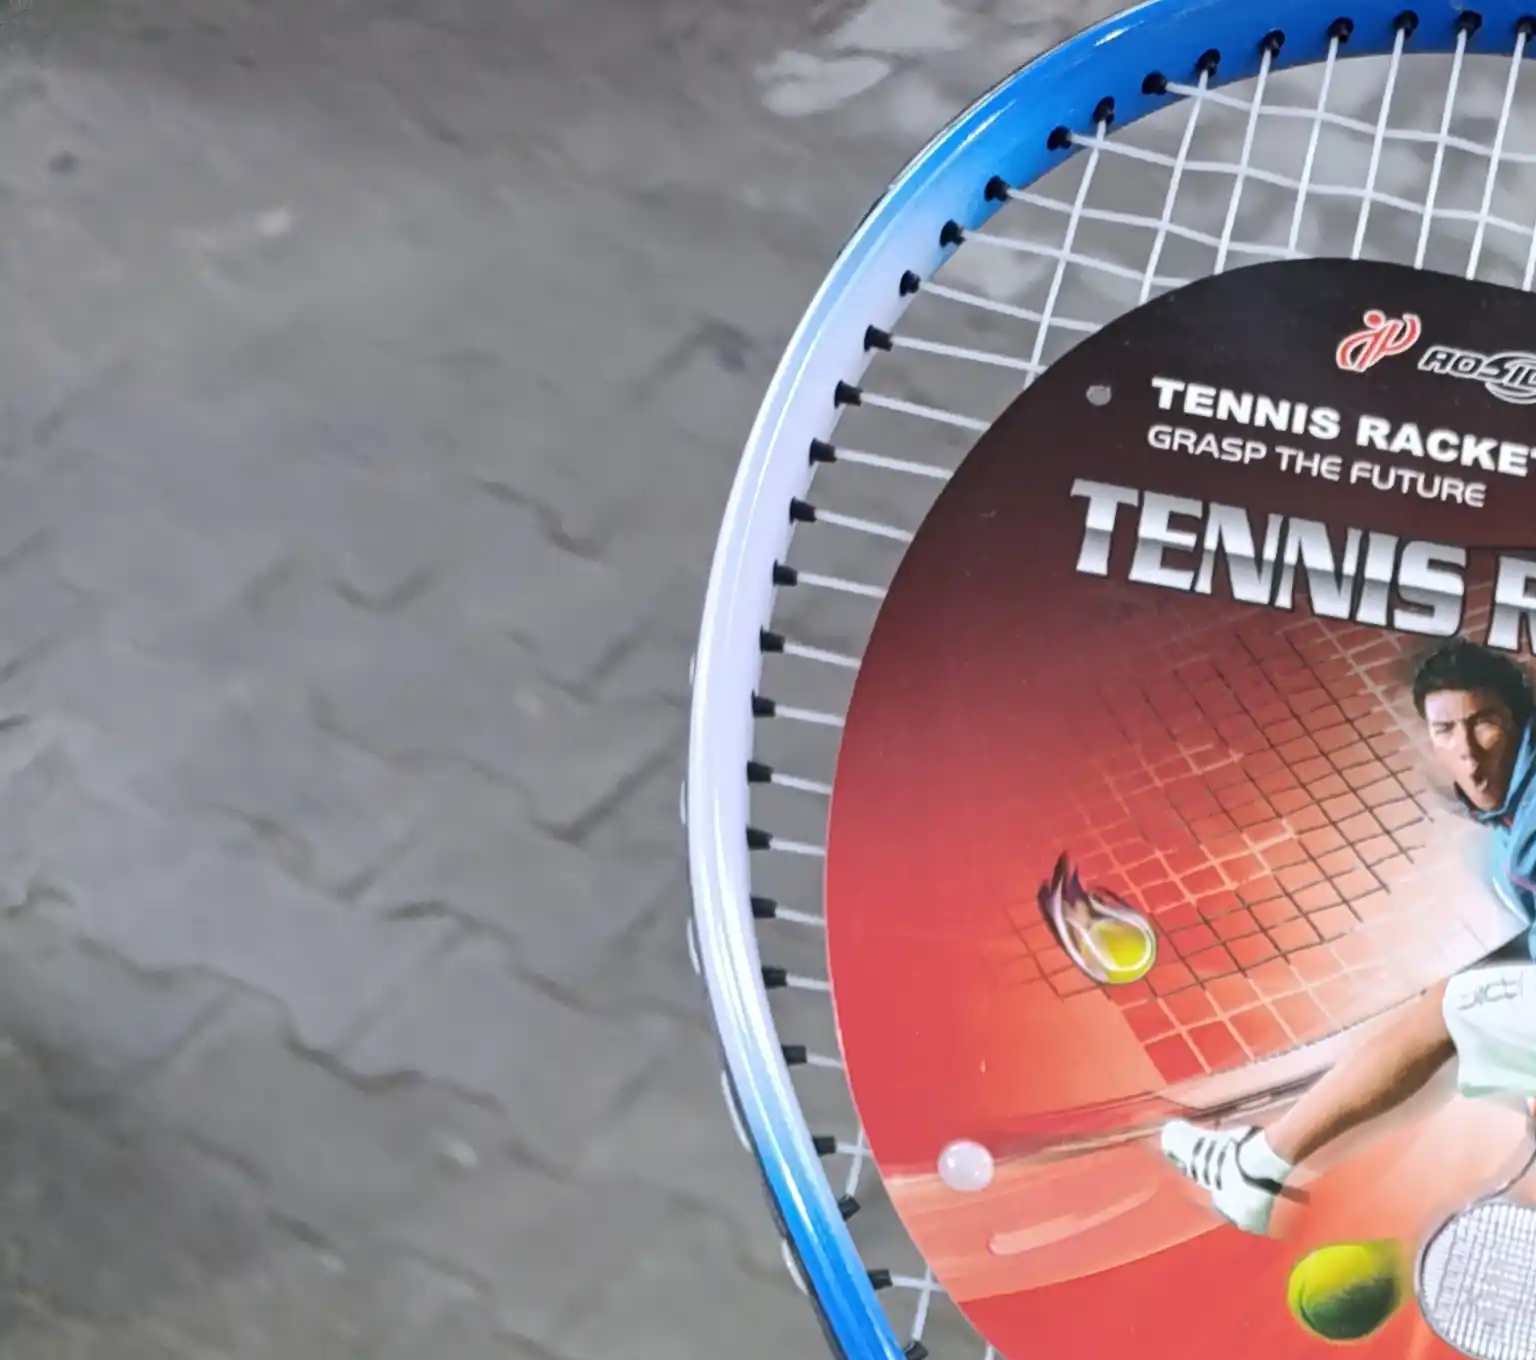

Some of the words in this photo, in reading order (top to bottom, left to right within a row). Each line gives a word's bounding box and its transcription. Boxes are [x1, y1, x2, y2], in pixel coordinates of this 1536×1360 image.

[1151, 377, 1341, 439] TENNIS
[1147, 424, 1266, 464] GRASP
[1275, 446, 1343, 481] THE
[1350, 461, 1487, 508] FUTURE
[1070, 478, 1467, 637] TENNIS
